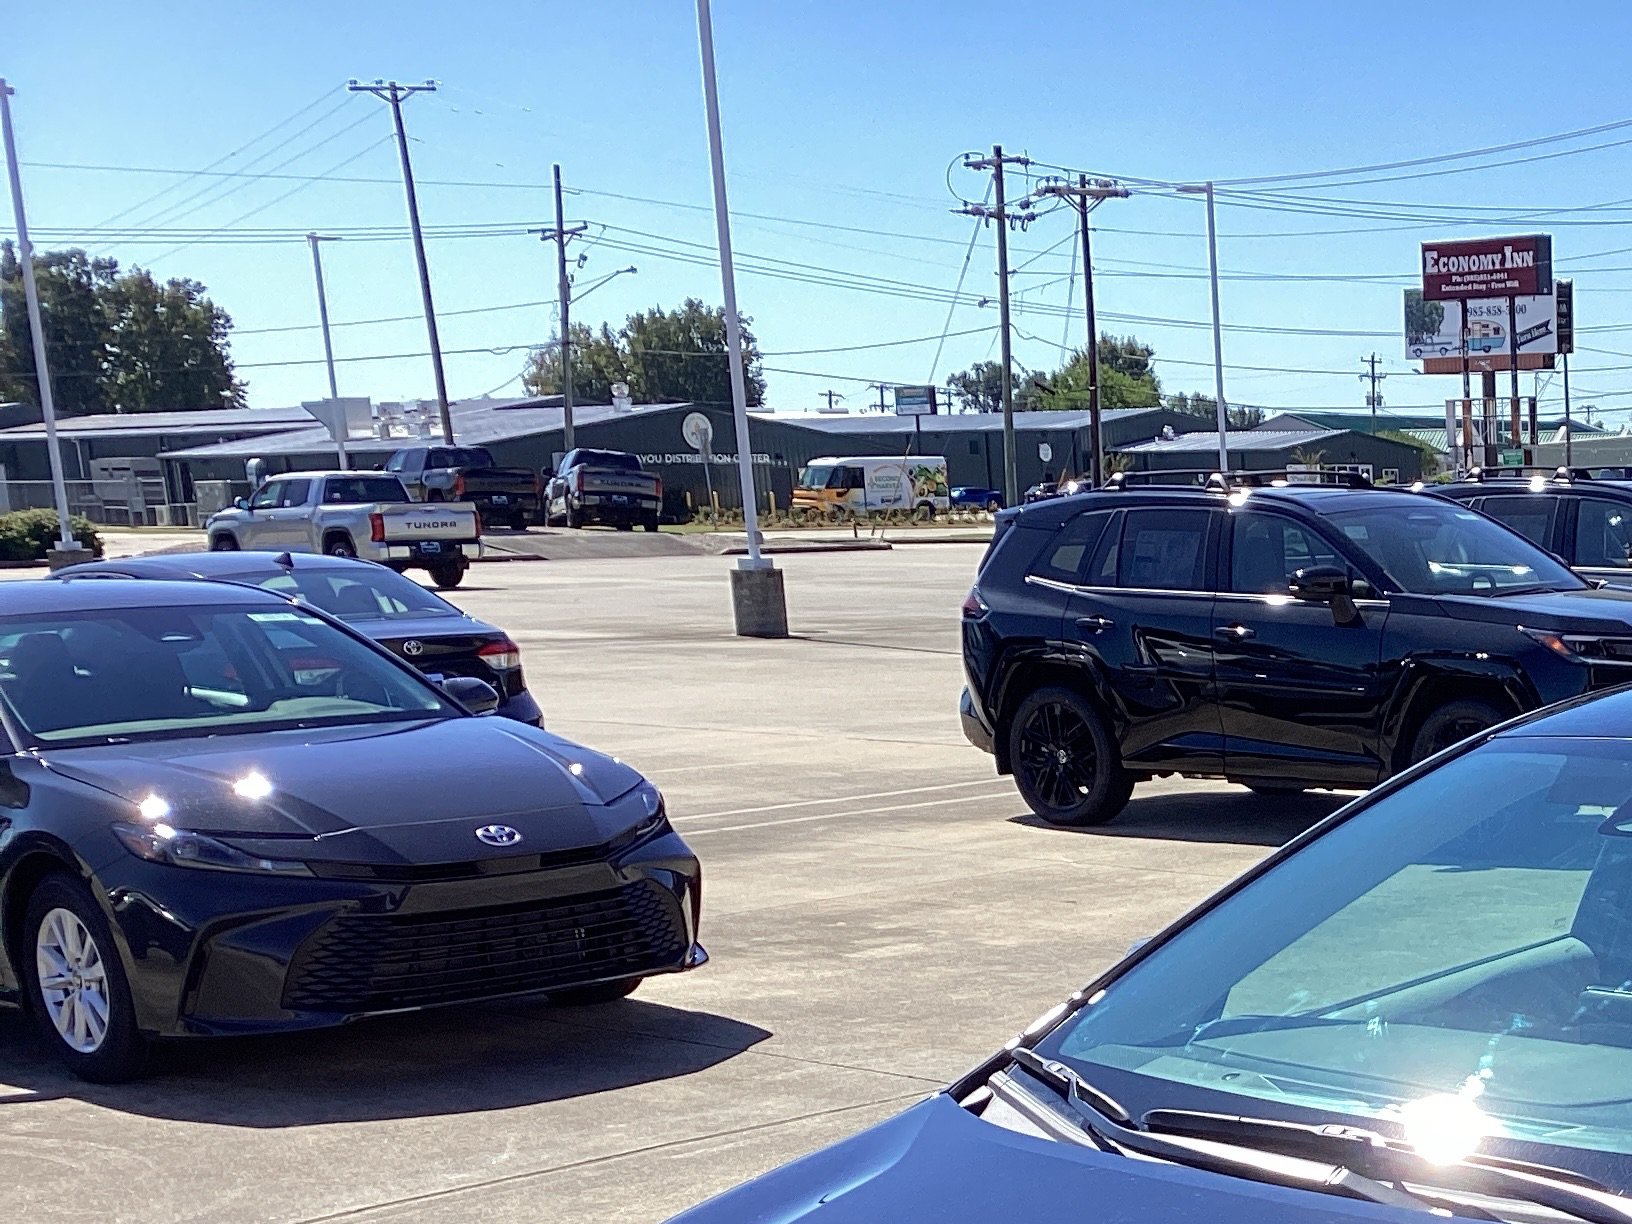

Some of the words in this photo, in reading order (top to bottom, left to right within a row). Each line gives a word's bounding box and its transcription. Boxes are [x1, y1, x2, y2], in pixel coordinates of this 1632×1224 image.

[1467, 304, 1527, 318] 985-858-00
[664, 453, 731, 465] DISTRIBTION
[733, 453, 770, 464] CTER
[405, 520, 457, 530] TUNDRA
